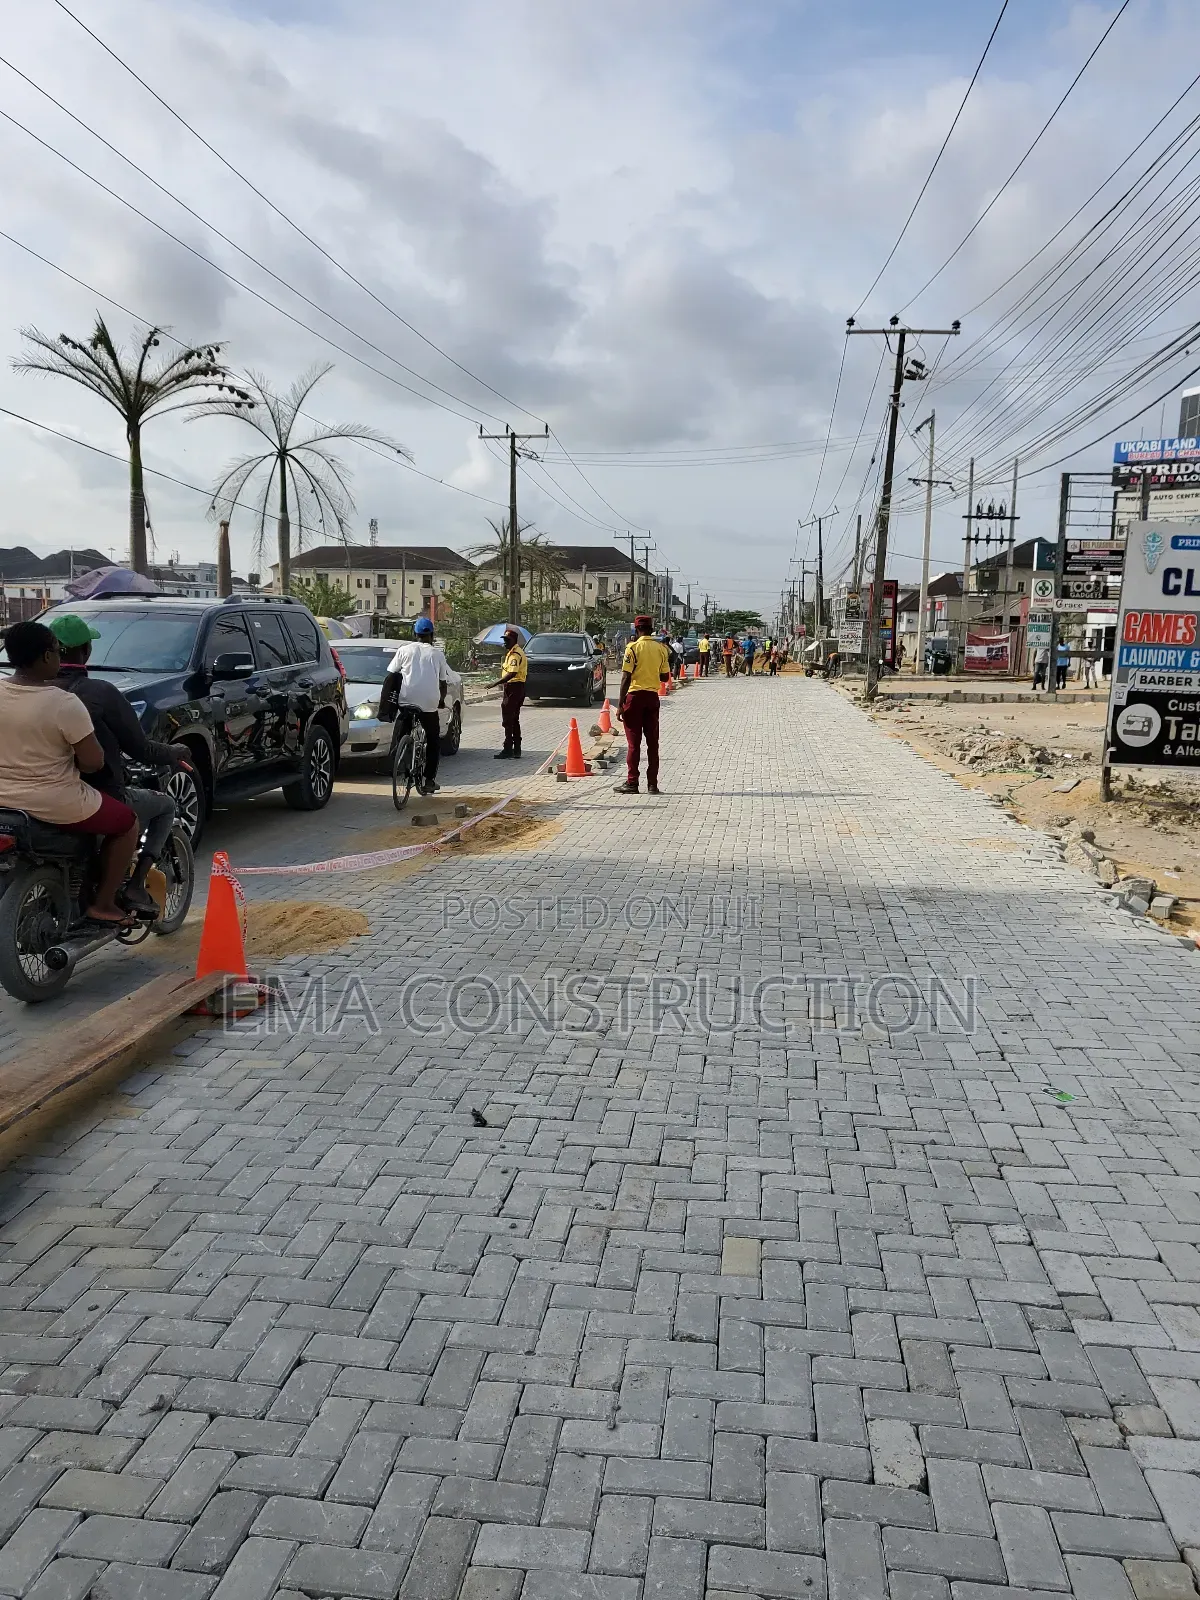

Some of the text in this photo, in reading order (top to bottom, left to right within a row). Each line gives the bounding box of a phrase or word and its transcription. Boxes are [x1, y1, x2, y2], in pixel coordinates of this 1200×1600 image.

[1120, 438, 1197, 453] UKPABI LAND
[1168, 474, 1200, 483] SALO
[1178, 538, 1200, 547] PRI
[1162, 567, 1200, 596] CL
[1055, 599, 1083, 609] Grace
[1123, 612, 1197, 645] GAMES
[1122, 648, 1186, 667] LAUNDRY
[1139, 675, 1193, 687] BARBER
[1162, 744, 1172, 755] &
